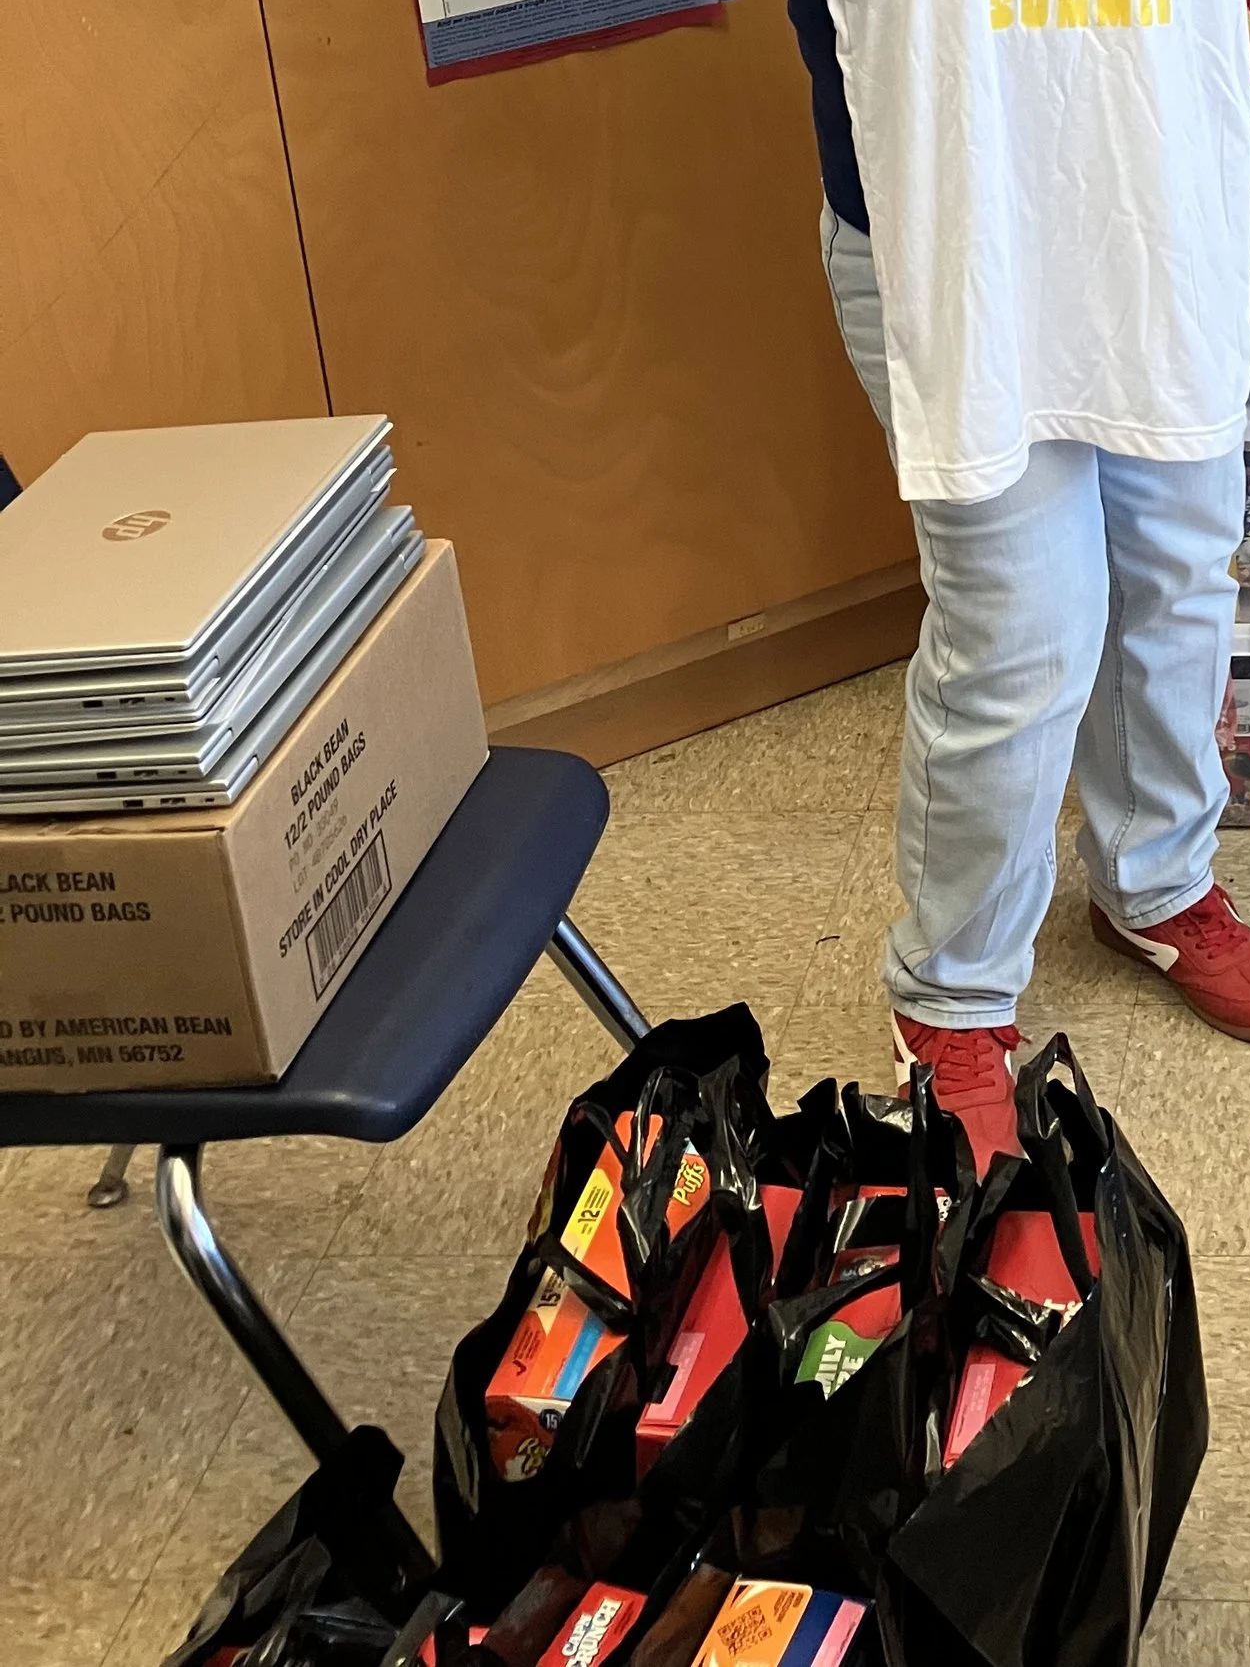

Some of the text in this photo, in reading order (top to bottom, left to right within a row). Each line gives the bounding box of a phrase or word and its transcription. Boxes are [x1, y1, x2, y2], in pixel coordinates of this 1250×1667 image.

[290, 718, 350, 806] BLACK BEAN
[283, 731, 367, 851] 12/2 POUND BAGS
[56, 871, 116, 893] BEAN
[278, 779, 399, 959] STORE IN COOL DRY PLACE
[10, 901, 151, 923] POUND BAGS
[19, 1019, 48, 1038] BY
[54, 1016, 169, 1037] AMERICAN
[173, 1015, 233, 1036] BEAN
[77, 1046, 113, 1063] MN
[118, 1044, 185, 1063] 56752
[673, 1162, 706, 1206] Puffs
